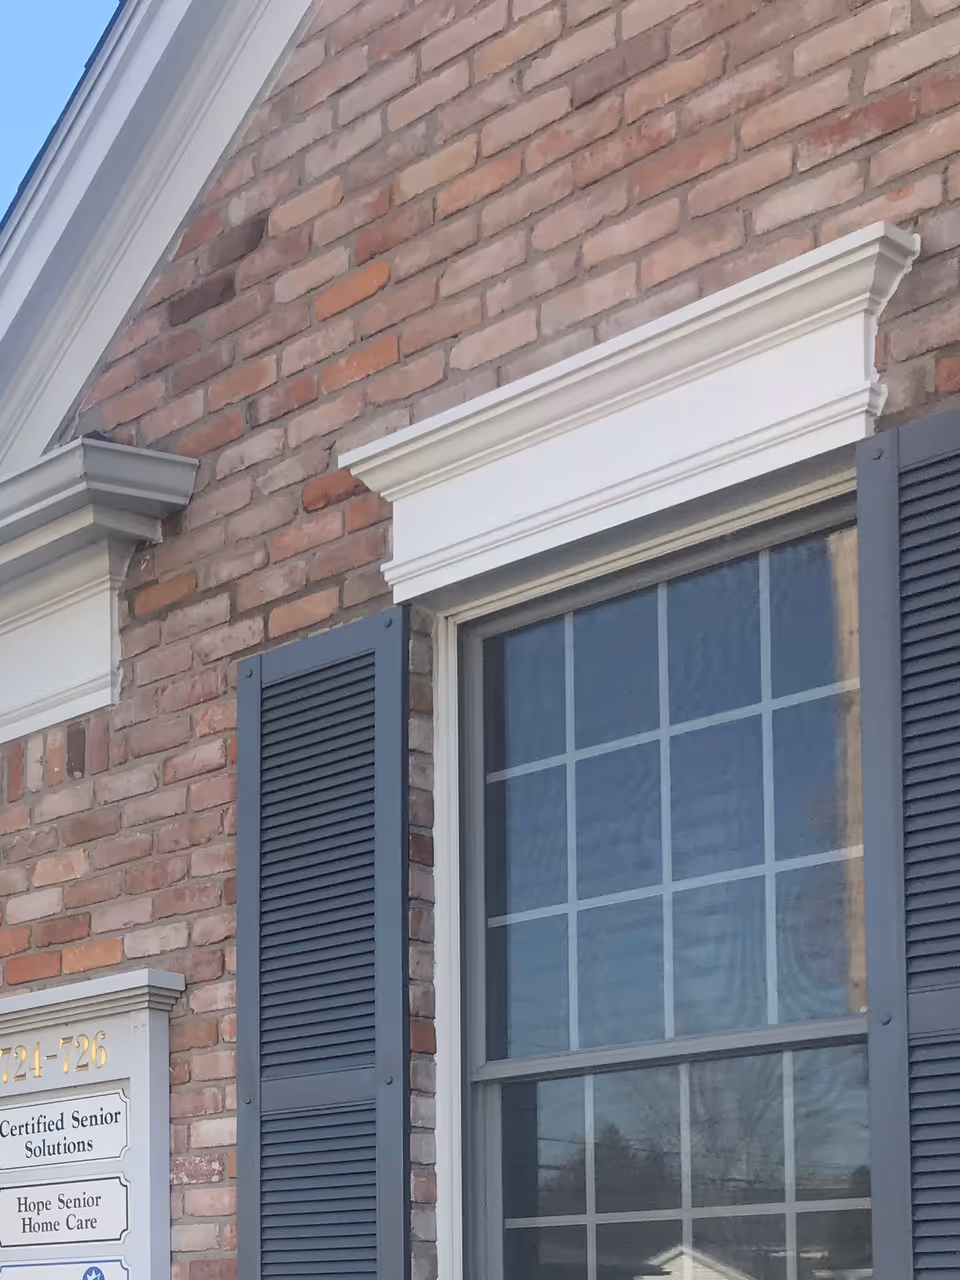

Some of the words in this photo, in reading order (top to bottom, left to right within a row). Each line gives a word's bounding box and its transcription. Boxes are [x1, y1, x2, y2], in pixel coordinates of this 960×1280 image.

[0, 1112, 65, 1138] Certified
[72, 1107, 121, 1129] Senior
[25, 1136, 93, 1158] Solutions
[17, 1196, 52, 1215] Hope
[58, 1192, 101, 1210] Senior
[21, 1217, 60, 1233] Home
[66, 1214, 97, 1230] Care
